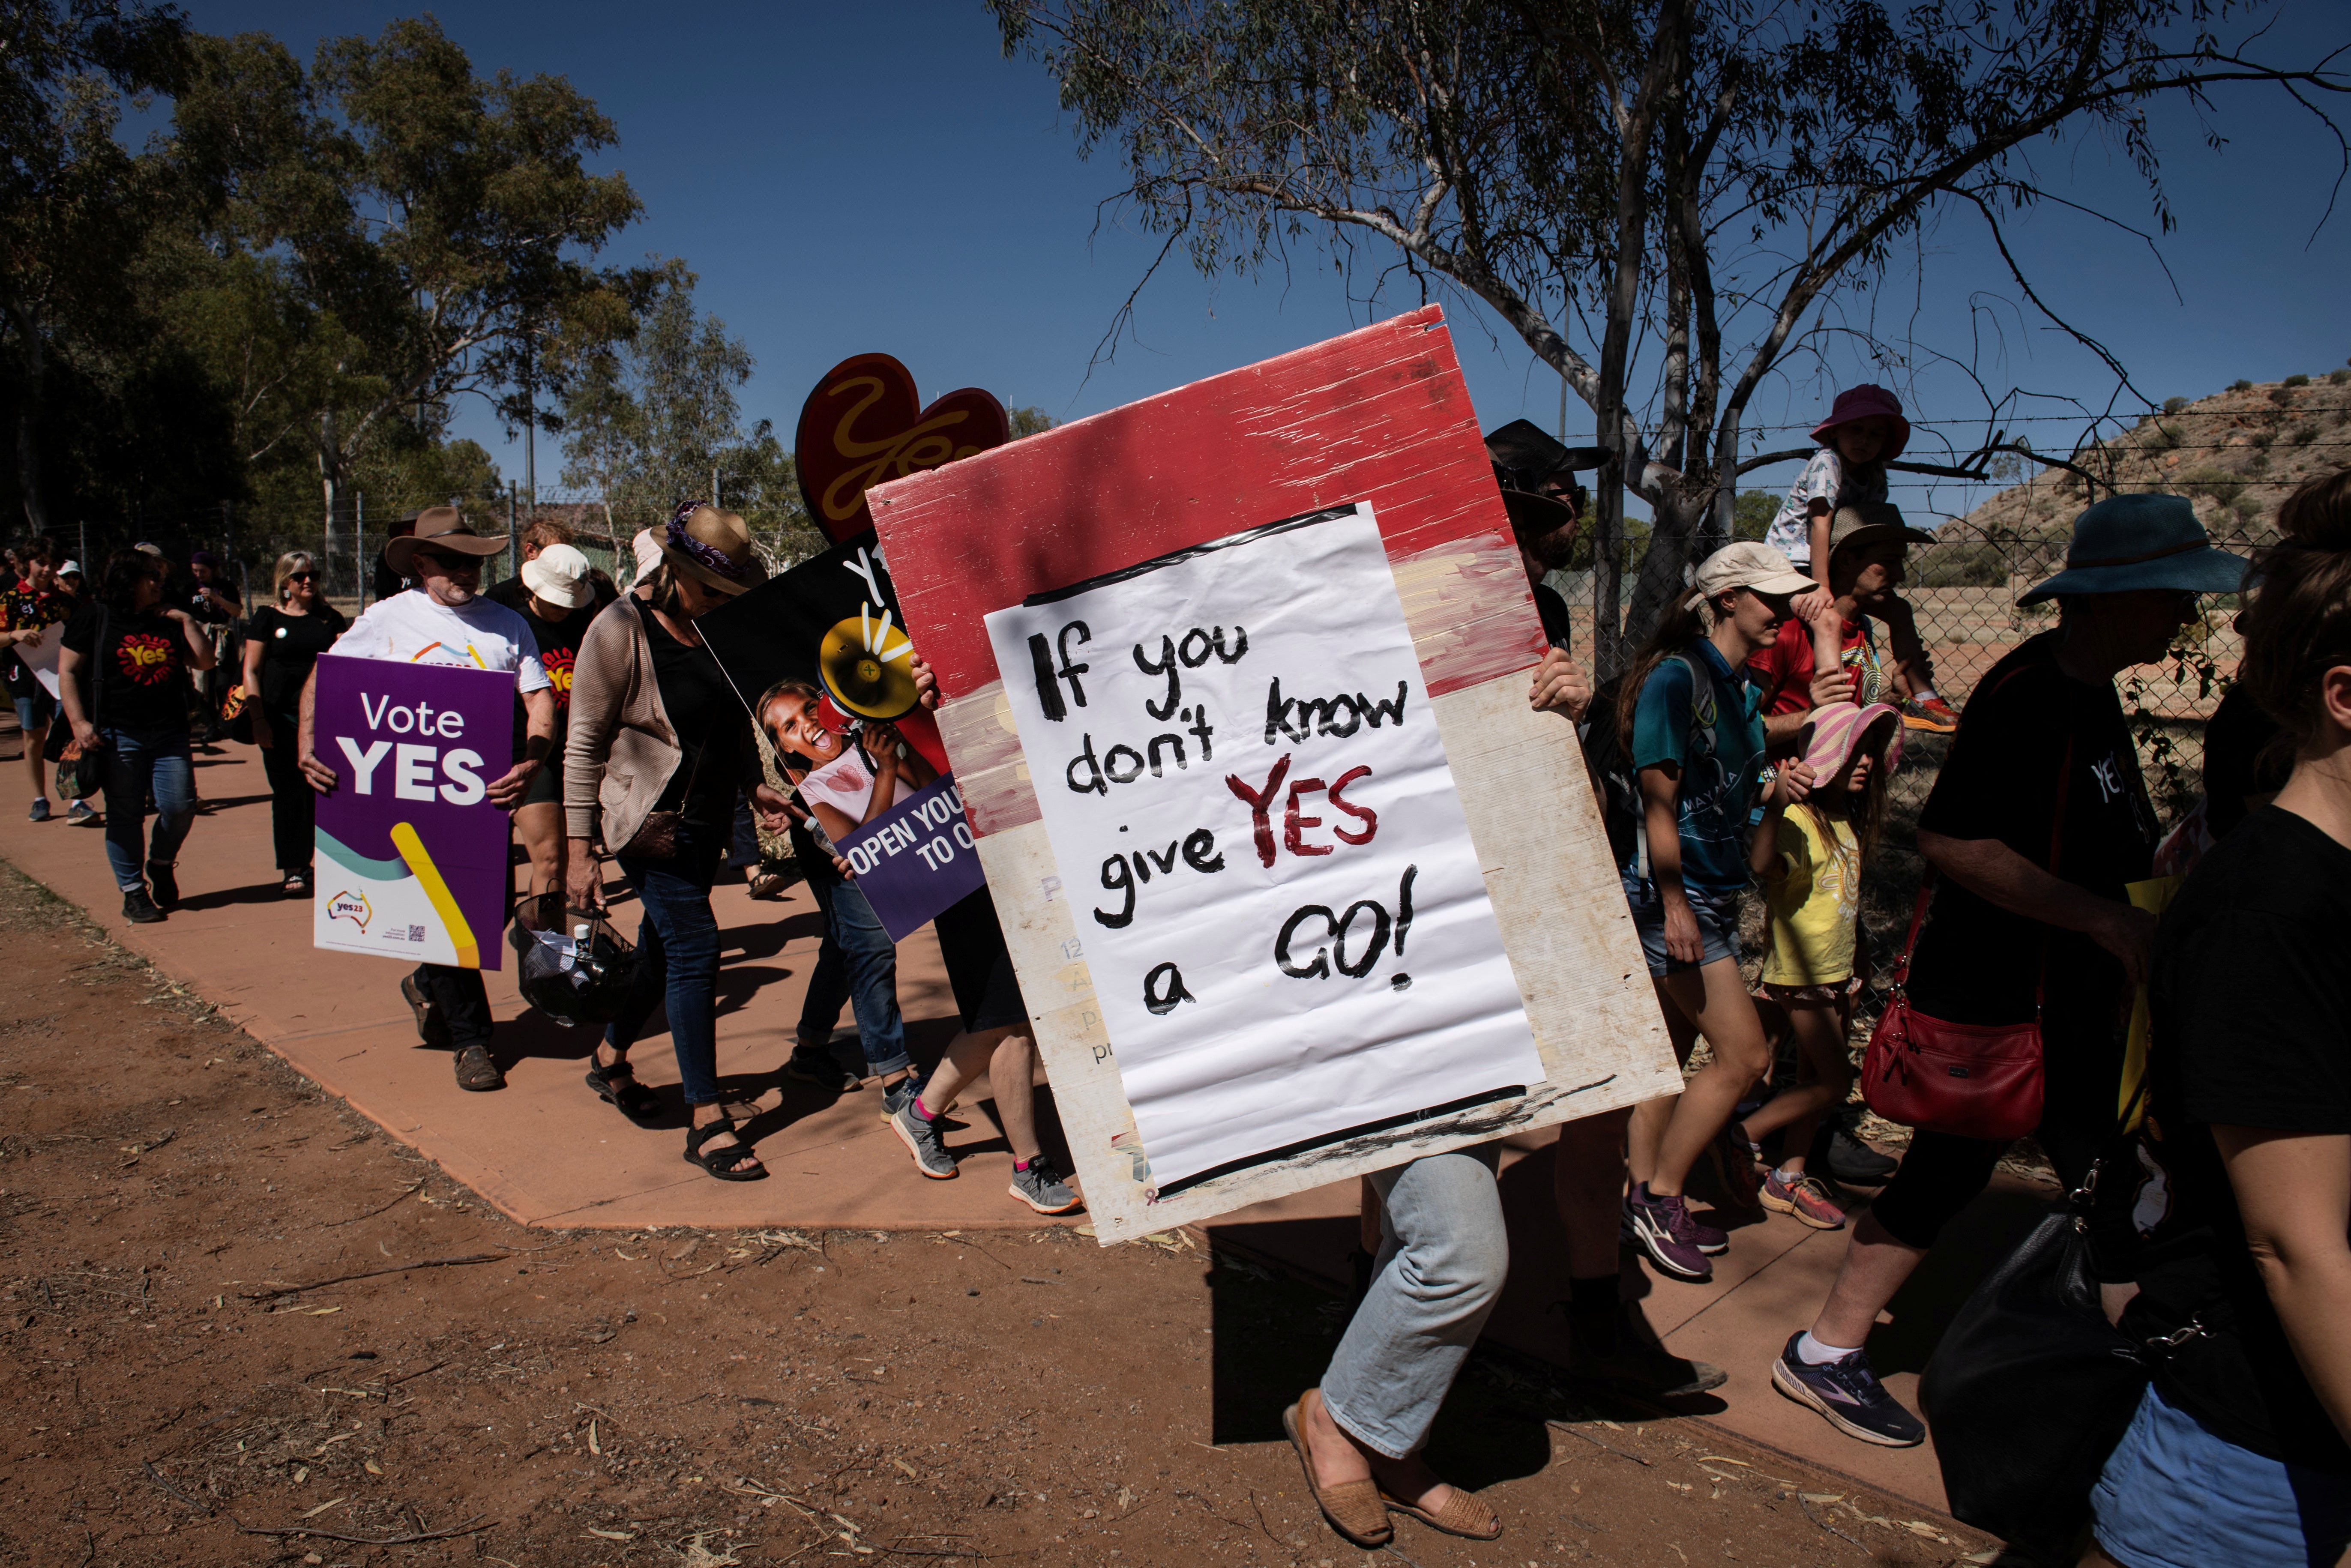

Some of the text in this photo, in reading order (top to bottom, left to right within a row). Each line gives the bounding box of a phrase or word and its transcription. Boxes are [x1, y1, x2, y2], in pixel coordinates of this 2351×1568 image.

[126, 645, 168, 666] Yes
[546, 667, 573, 692] Ye
[1028, 620, 1249, 722] If you
[360, 692, 464, 738] Vote
[1067, 676, 1407, 796] don't know
[335, 736, 486, 806] YES
[848, 817, 917, 874] OPEN
[915, 836, 955, 871] TO
[1094, 753, 1378, 929] give YES
[1144, 864, 1418, 1015] a GO!
